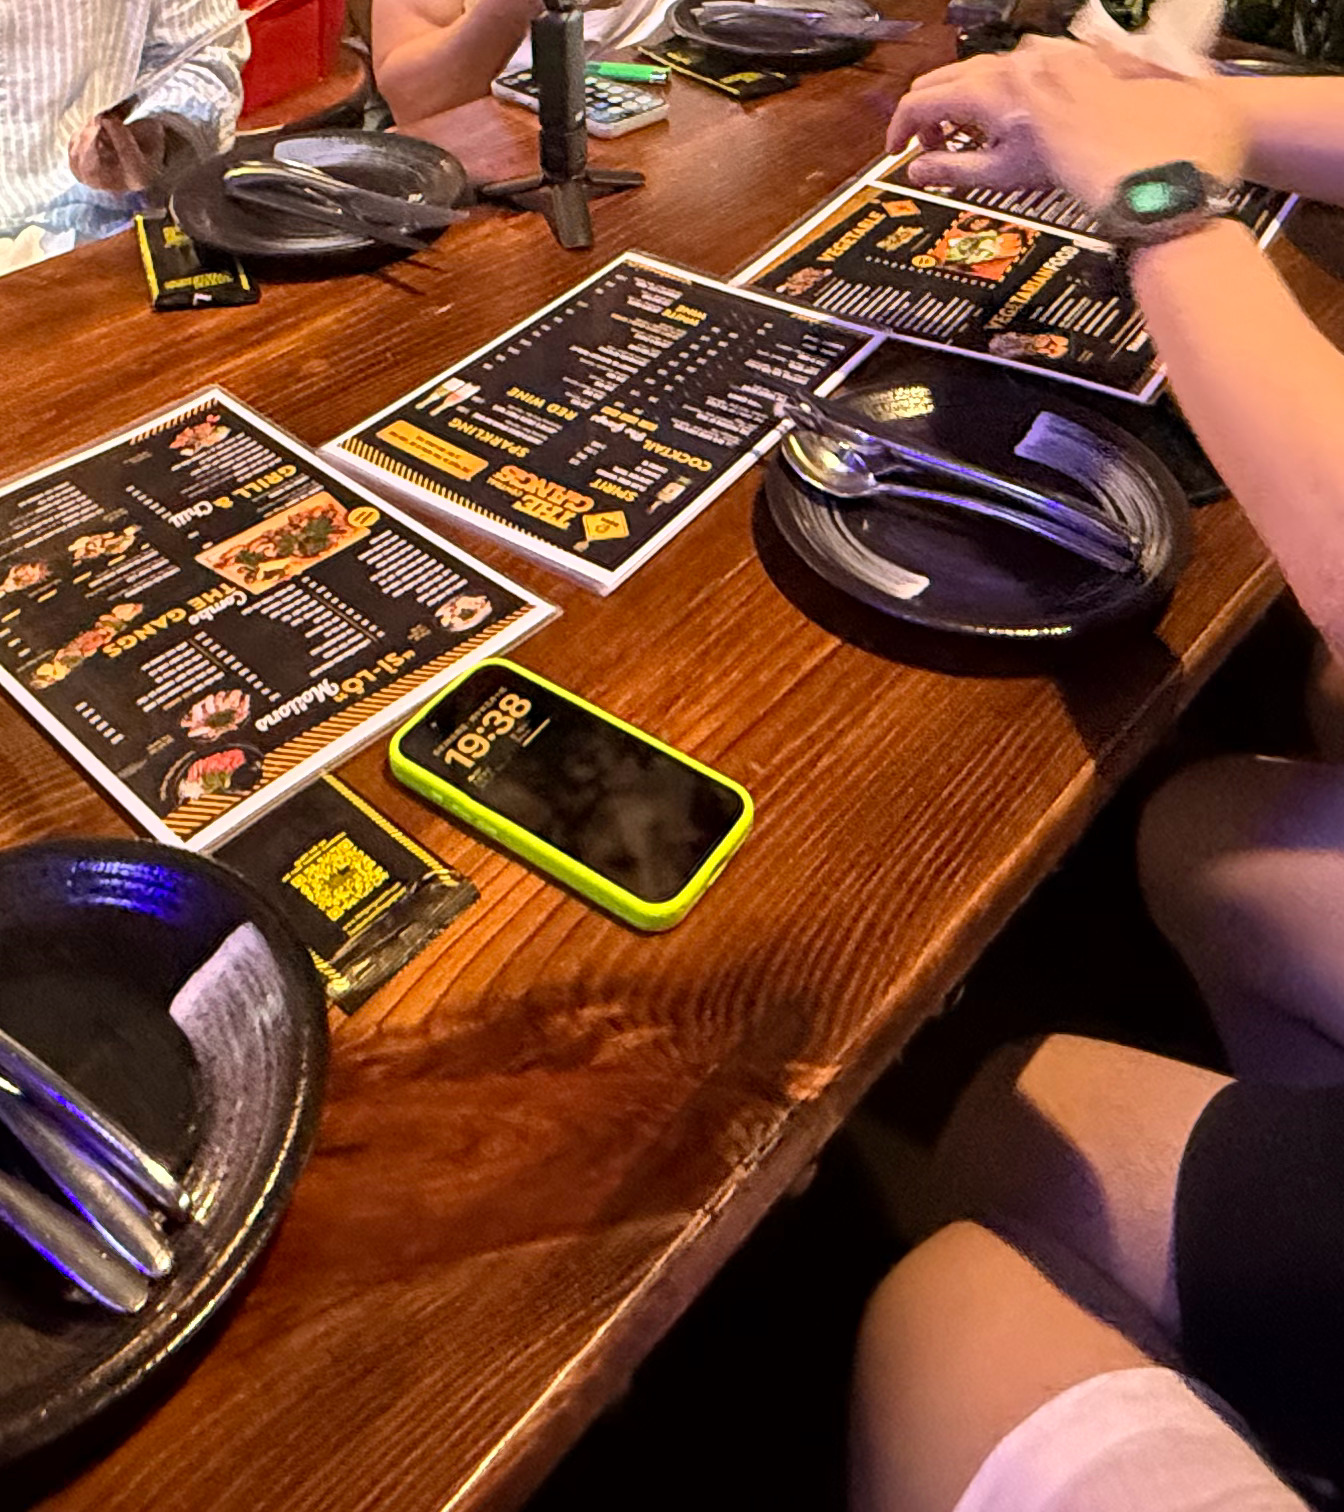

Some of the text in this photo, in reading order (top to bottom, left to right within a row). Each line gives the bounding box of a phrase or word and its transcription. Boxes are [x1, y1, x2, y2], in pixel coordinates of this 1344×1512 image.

[816, 210, 887, 263] VEGETABLE
[983, 266, 1056, 331] VEGETARIAN
[1049, 244, 1081, 272] FOOD
[506, 386, 579, 422] RED WINE
[447, 417, 530, 458] SPARKLING
[641, 439, 713, 473] COCKTAIL
[232, 464, 298, 500] GRILL
[500, 465, 595, 514] GANGS
[589, 477, 639, 503] SPIRIT
[512, 493, 579, 530] THE
[101, 582, 237, 659] THE GANGS
[188, 589, 248, 626] Combo
[254, 678, 340, 733] Motions
[443, 692, 533, 770] 19:38
